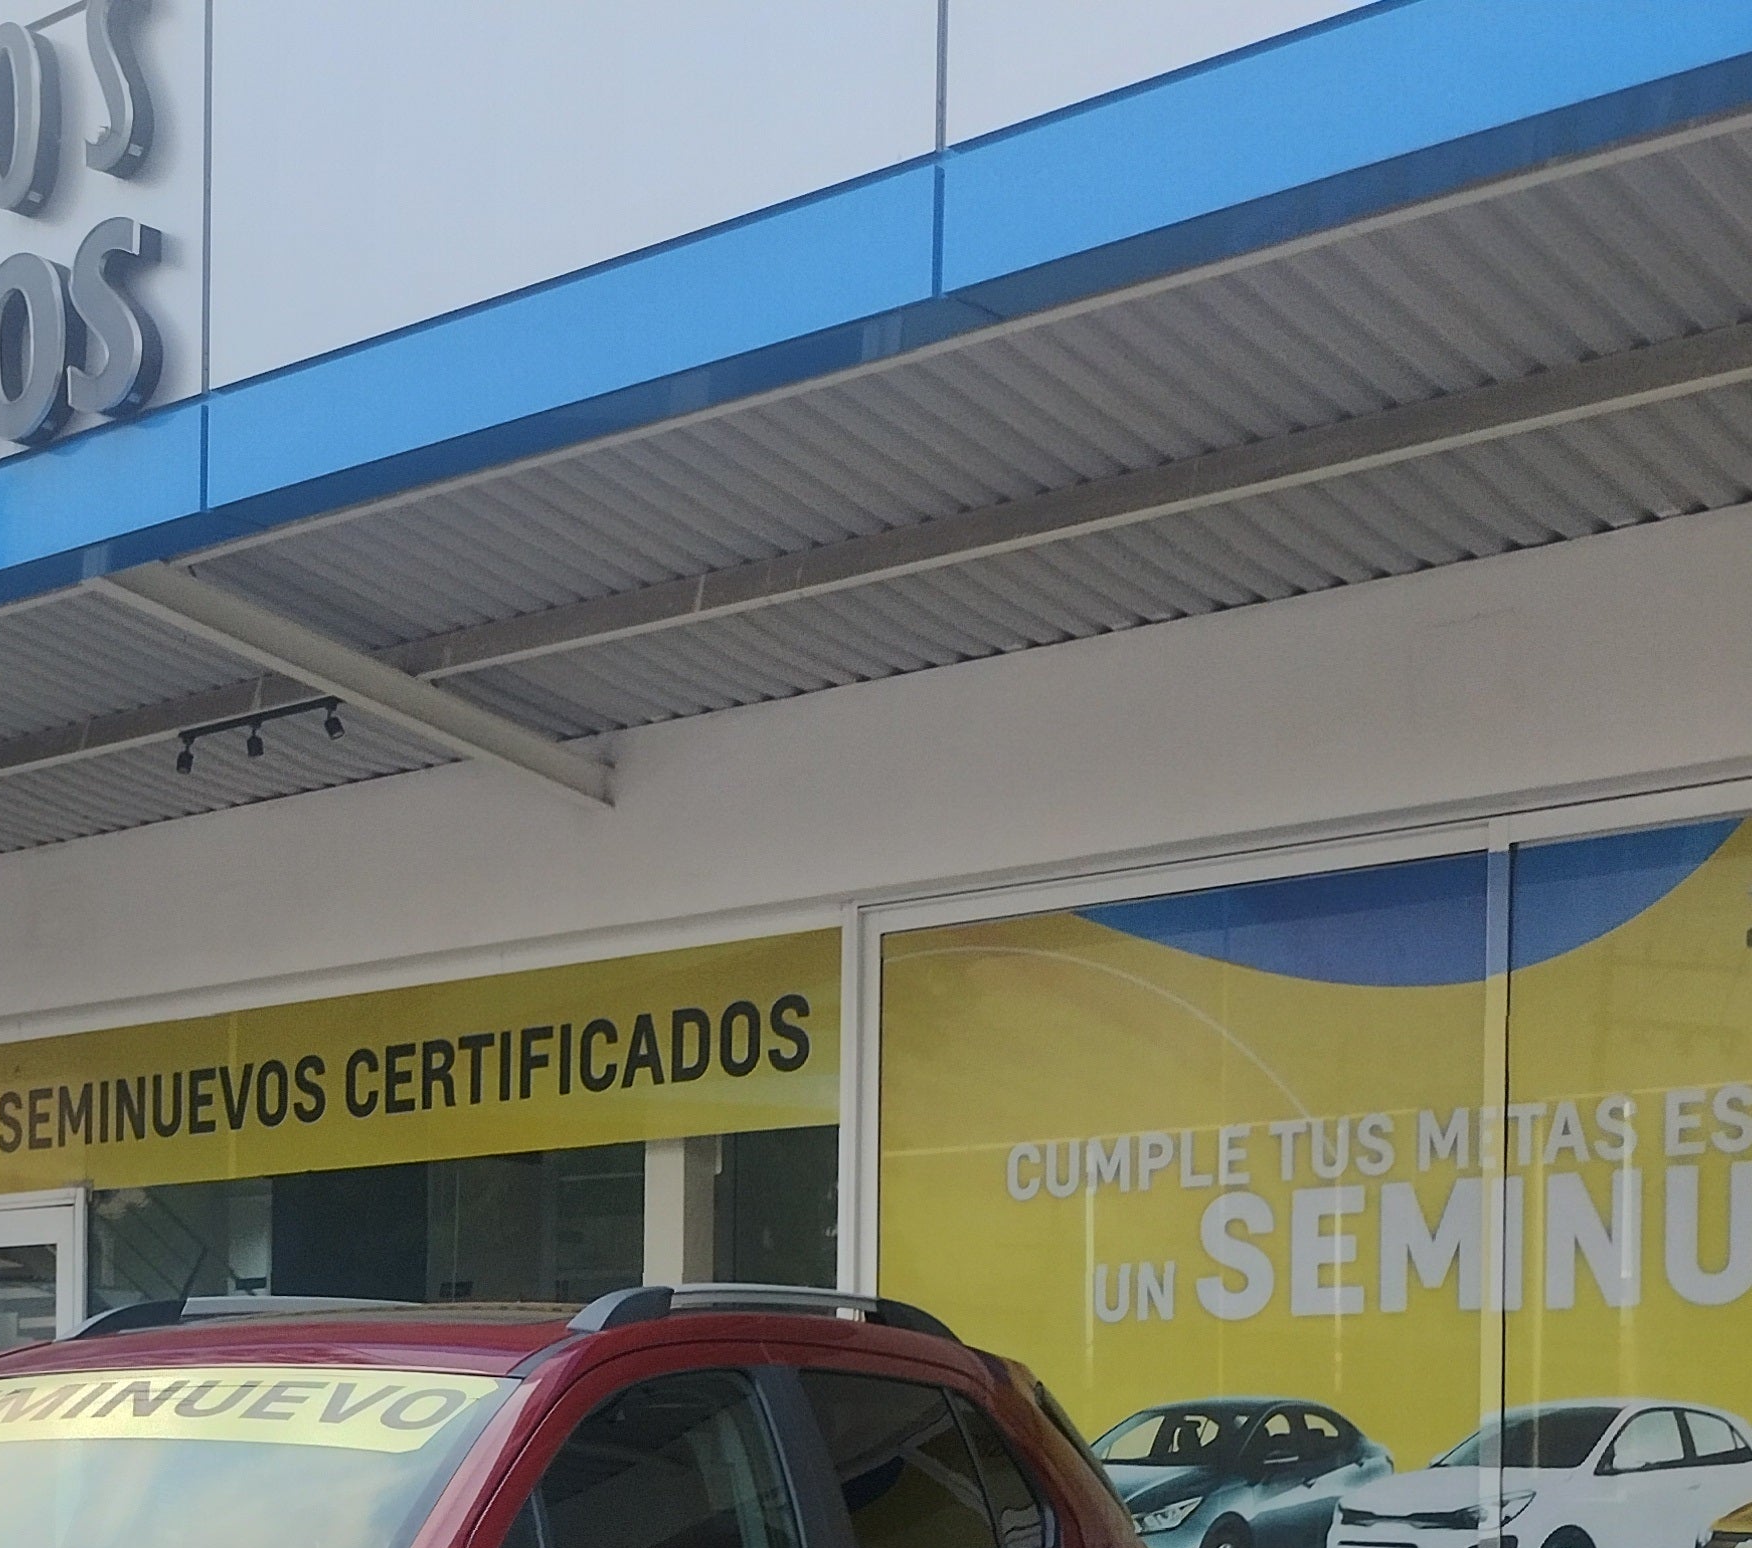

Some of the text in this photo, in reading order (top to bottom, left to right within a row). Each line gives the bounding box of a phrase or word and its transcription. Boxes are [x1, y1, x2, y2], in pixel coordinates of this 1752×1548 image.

[345, 994, 810, 1118] CERTIFICADOS
[1006, 1124, 1252, 1202] CUMPLE
[1268, 1111, 1395, 1181] TUS
[1417, 1092, 1639, 1173] METAS
[1095, 1260, 1176, 1324] UN
